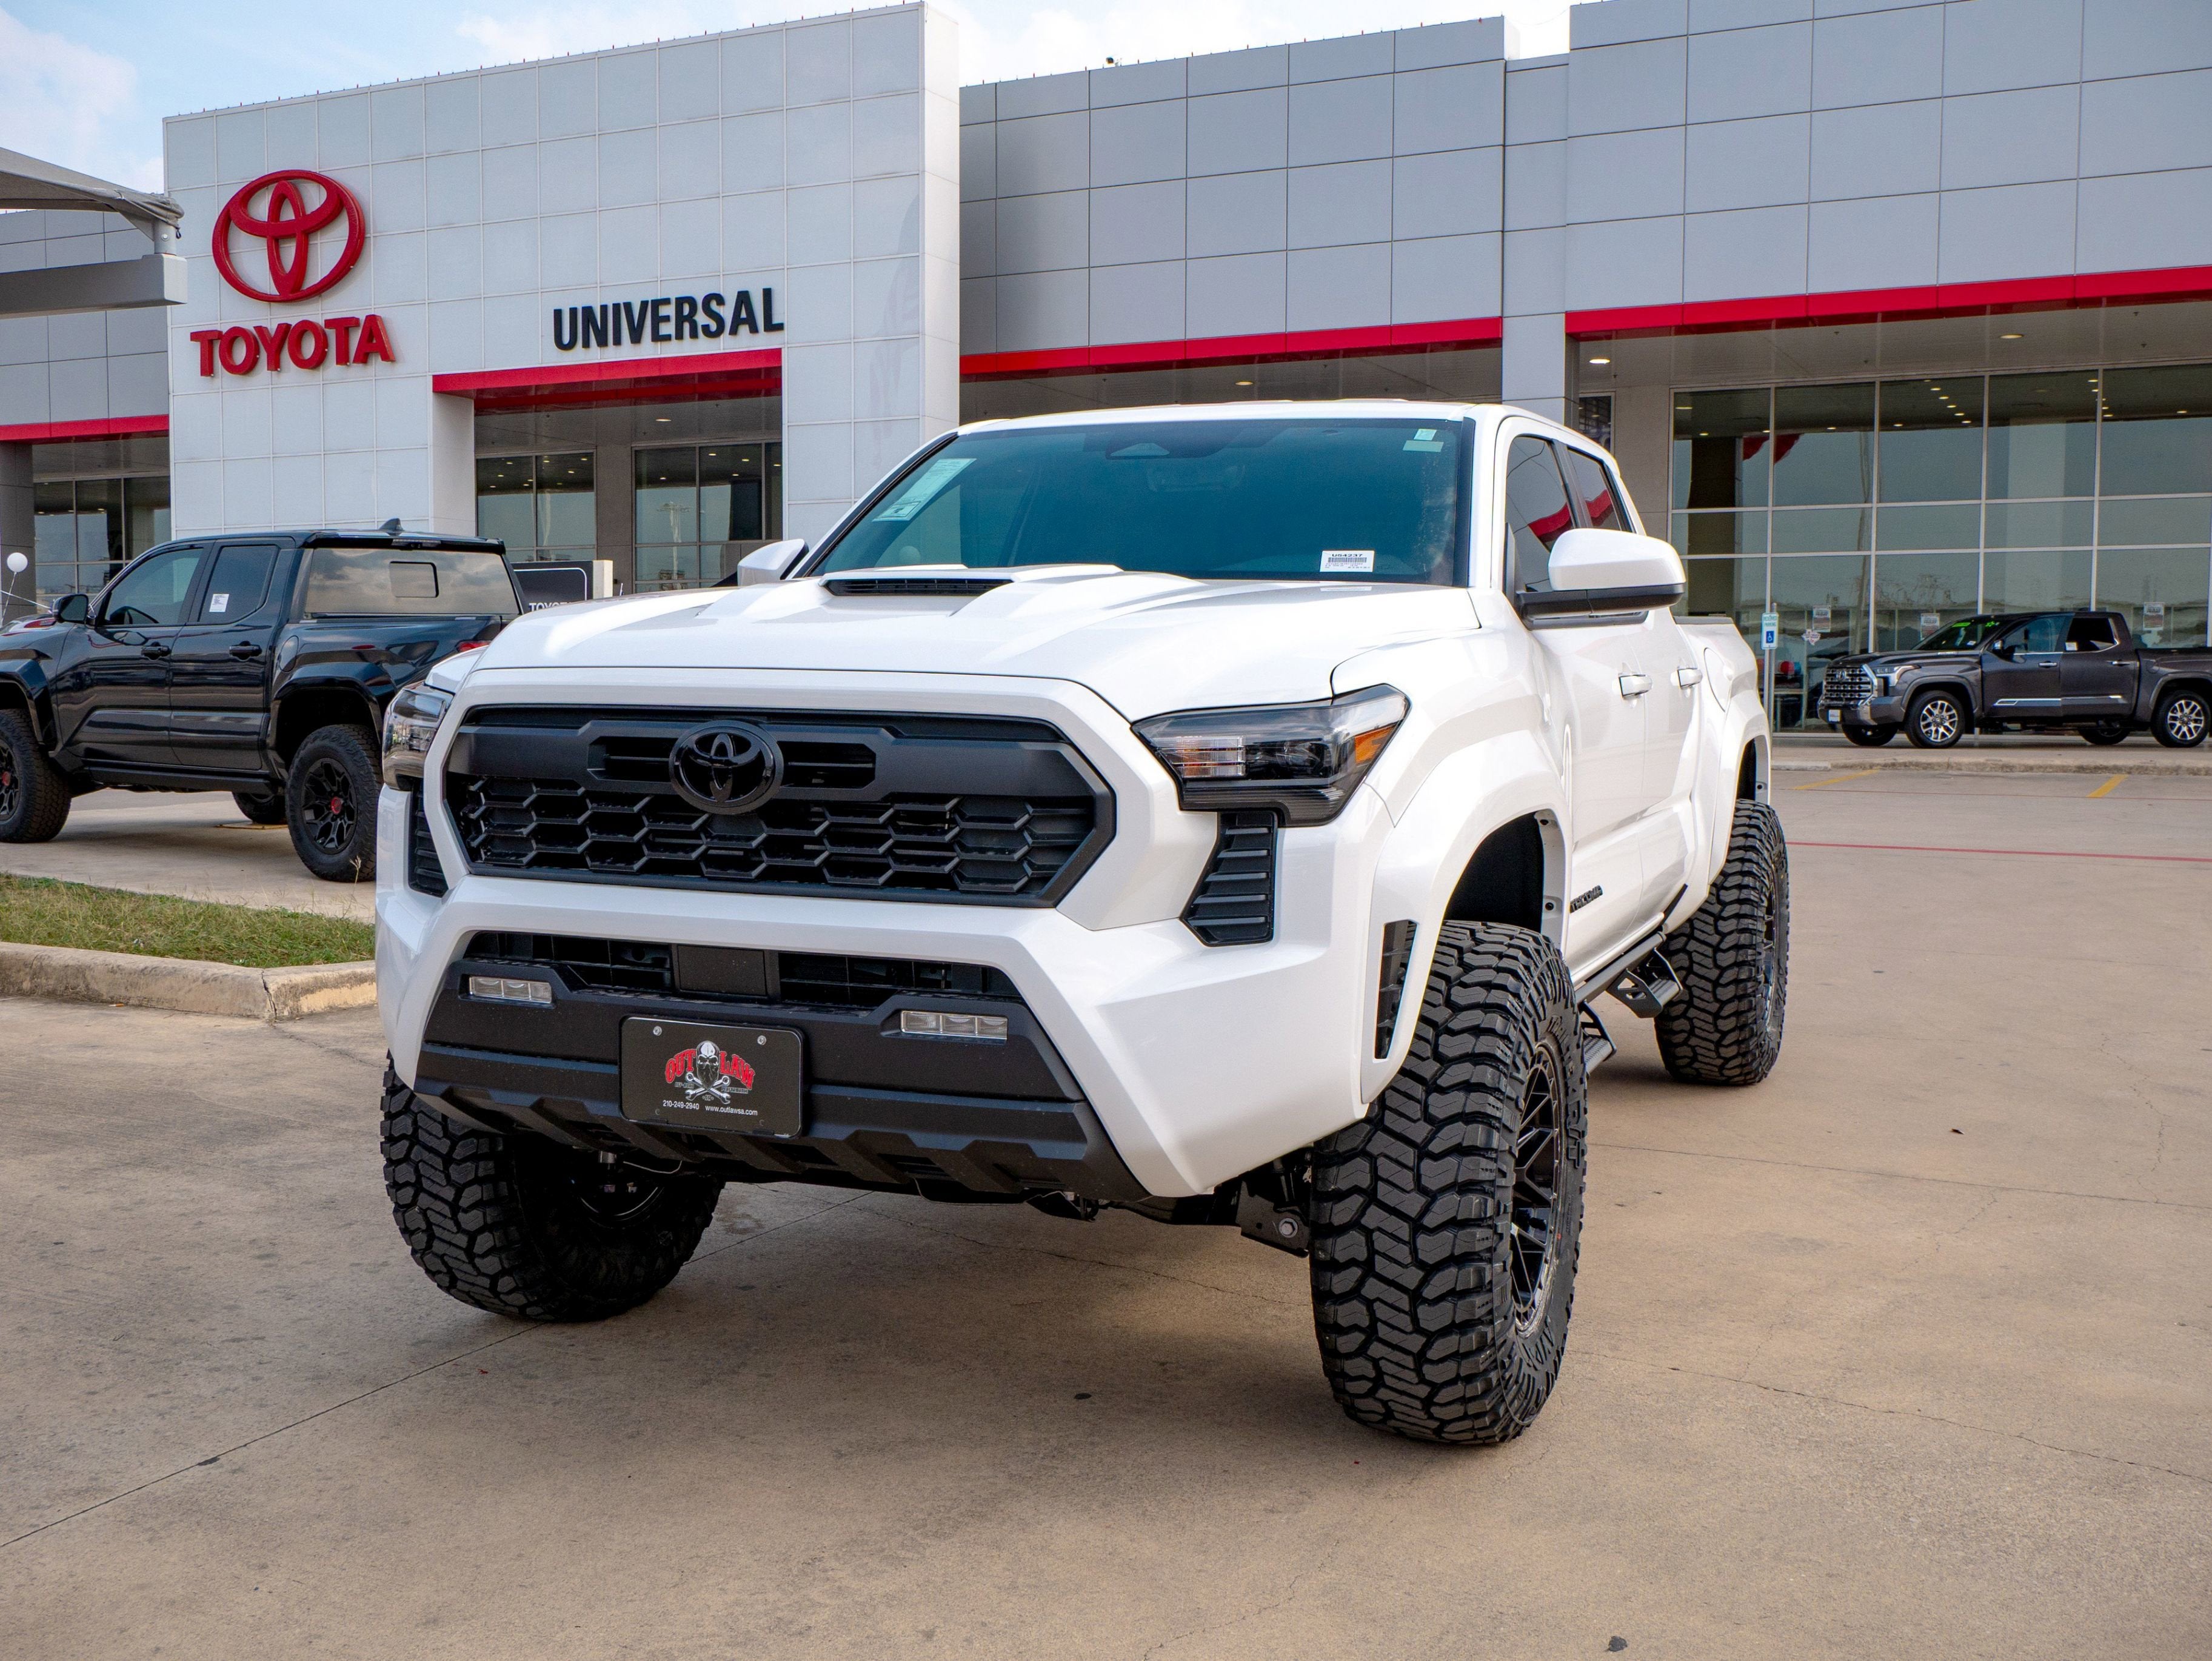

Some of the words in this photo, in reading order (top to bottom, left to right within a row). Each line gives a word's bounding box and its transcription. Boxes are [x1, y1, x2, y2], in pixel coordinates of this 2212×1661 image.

[190, 315, 395, 377] TOYOTA
[552, 287, 784, 351] UNIVERSAL
[663, 1100, 700, 1110] 210-249-2940
[705, 1105, 758, 1115] www.outlawsa.com
